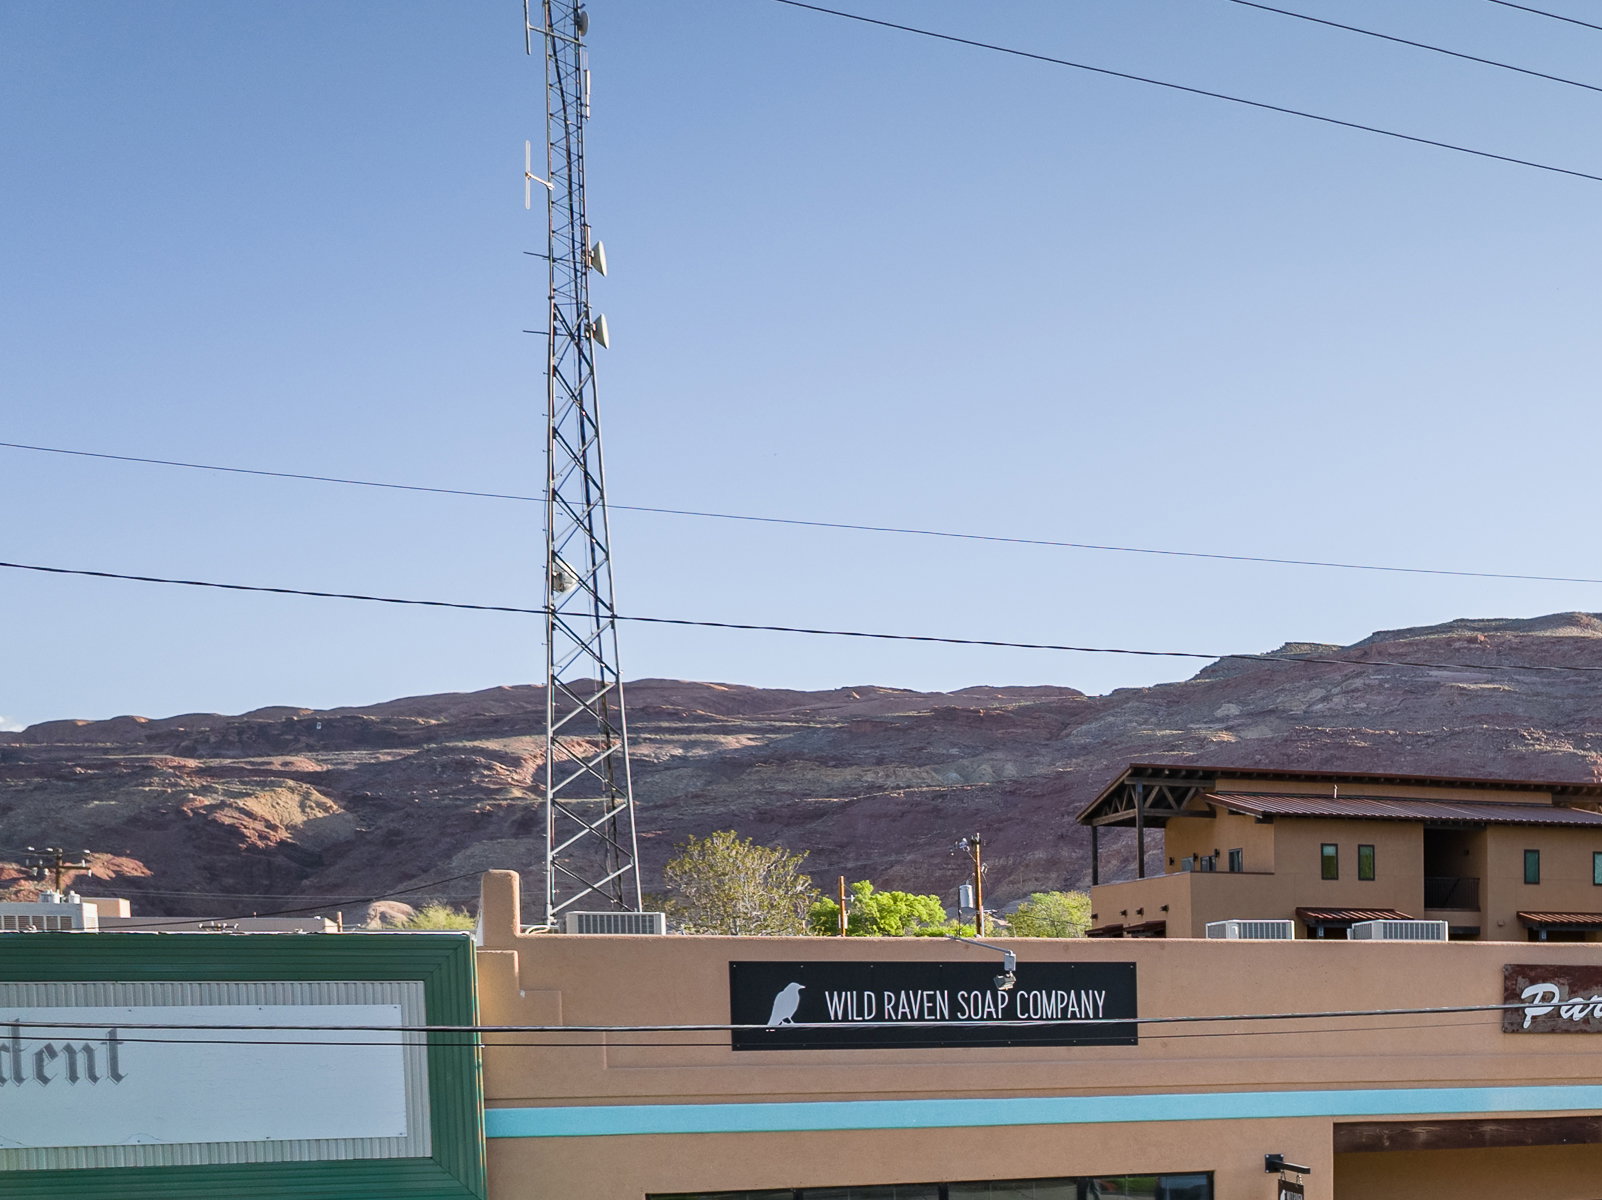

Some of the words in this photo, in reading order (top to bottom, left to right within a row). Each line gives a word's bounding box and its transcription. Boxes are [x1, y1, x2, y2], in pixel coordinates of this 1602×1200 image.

[825, 991, 876, 1020] WILD
[884, 990, 949, 1020] RAVEN
[957, 990, 1009, 1019] SOAP
[1016, 990, 1106, 1019] COMPANY
